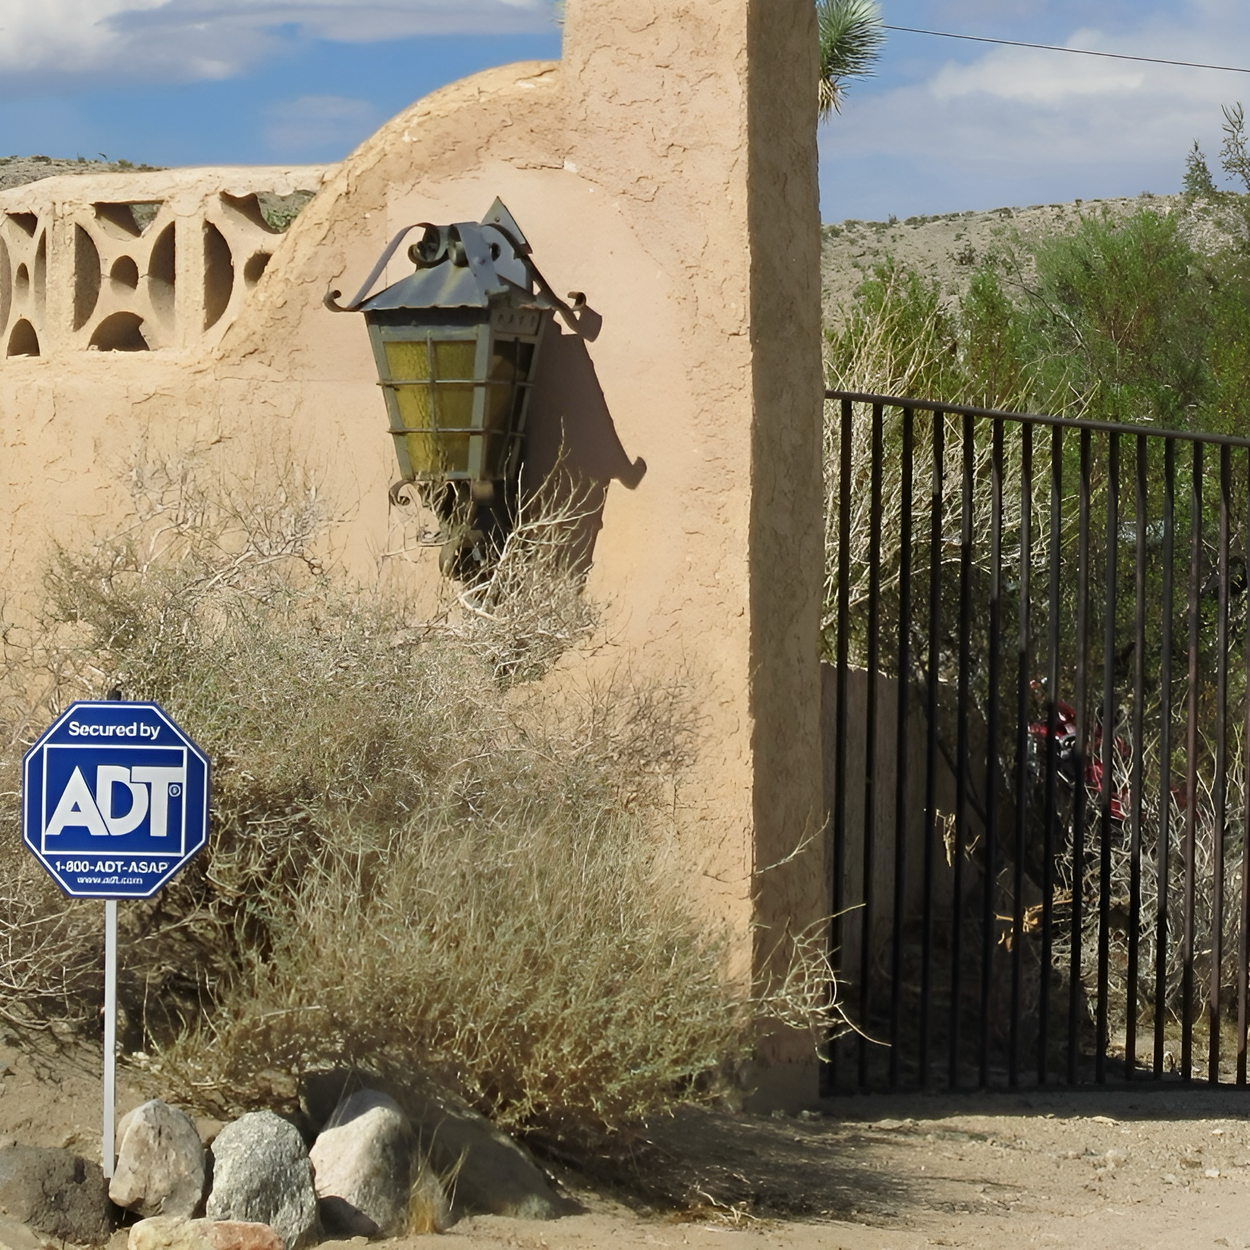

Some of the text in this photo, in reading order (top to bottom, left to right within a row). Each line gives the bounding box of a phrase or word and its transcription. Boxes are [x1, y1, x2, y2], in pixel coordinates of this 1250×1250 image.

[68, 721, 161, 740] Secured by
[55, 860, 169, 874] 1-800-ADT-ASAP
